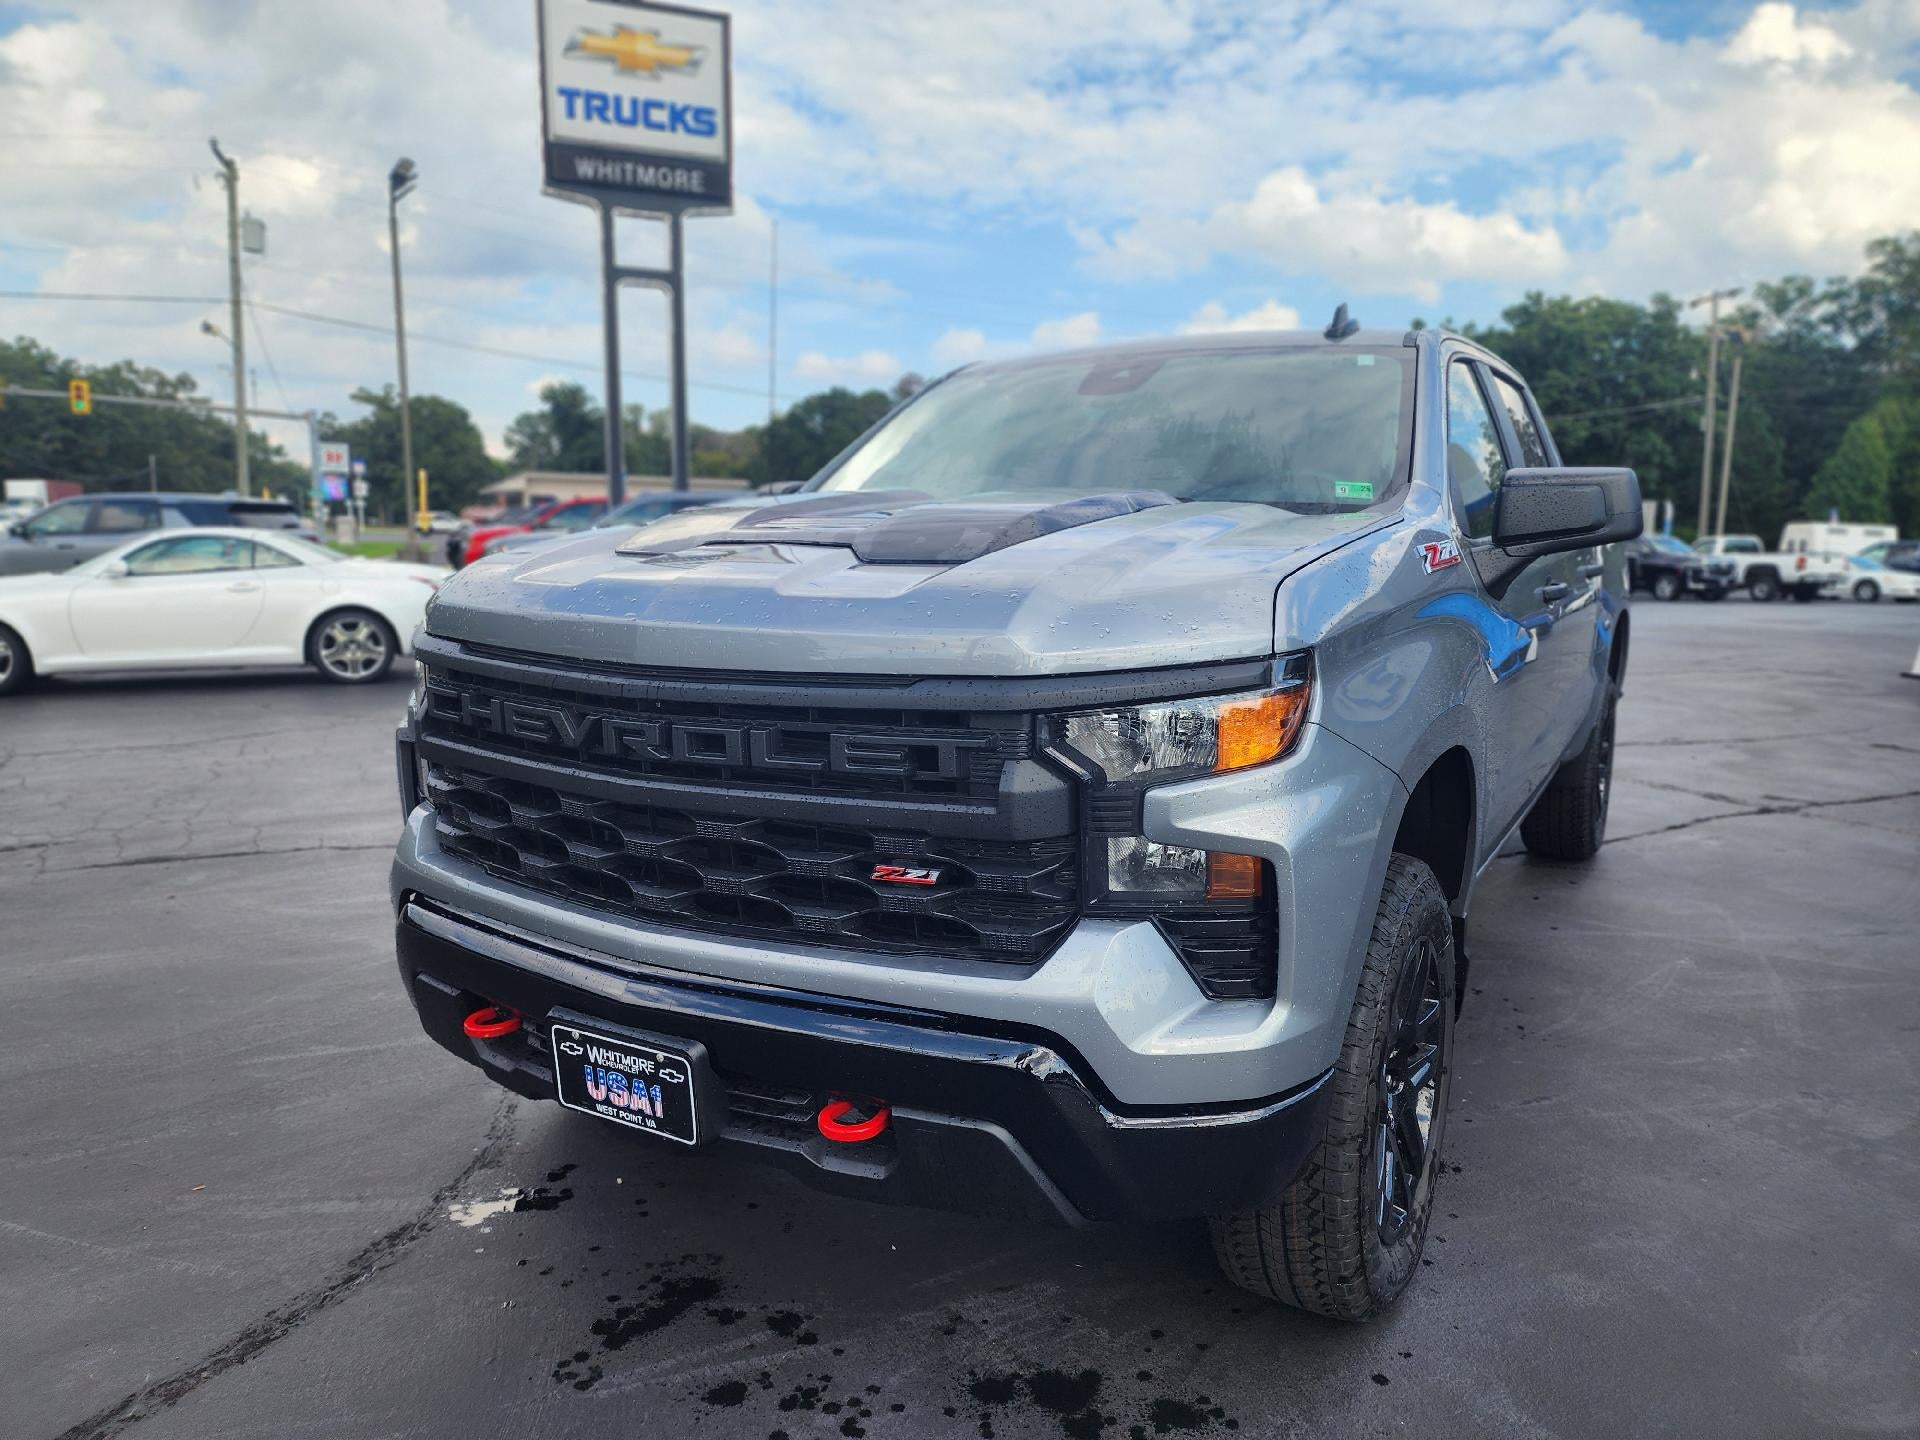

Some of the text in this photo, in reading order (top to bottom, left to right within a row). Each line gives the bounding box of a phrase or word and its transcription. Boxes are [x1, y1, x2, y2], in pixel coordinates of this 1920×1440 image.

[557, 86, 717, 138] TRUCKS
[574, 157, 704, 192] WHITMORE
[1414, 539, 1461, 575] Z71
[427, 685, 997, 780] CHEVROLET
[870, 865, 940, 885] Z71
[586, 1044, 655, 1075] WHITMORE
[601, 1059, 640, 1075] CHEVROLET
[595, 1103, 617, 1116] WEST
